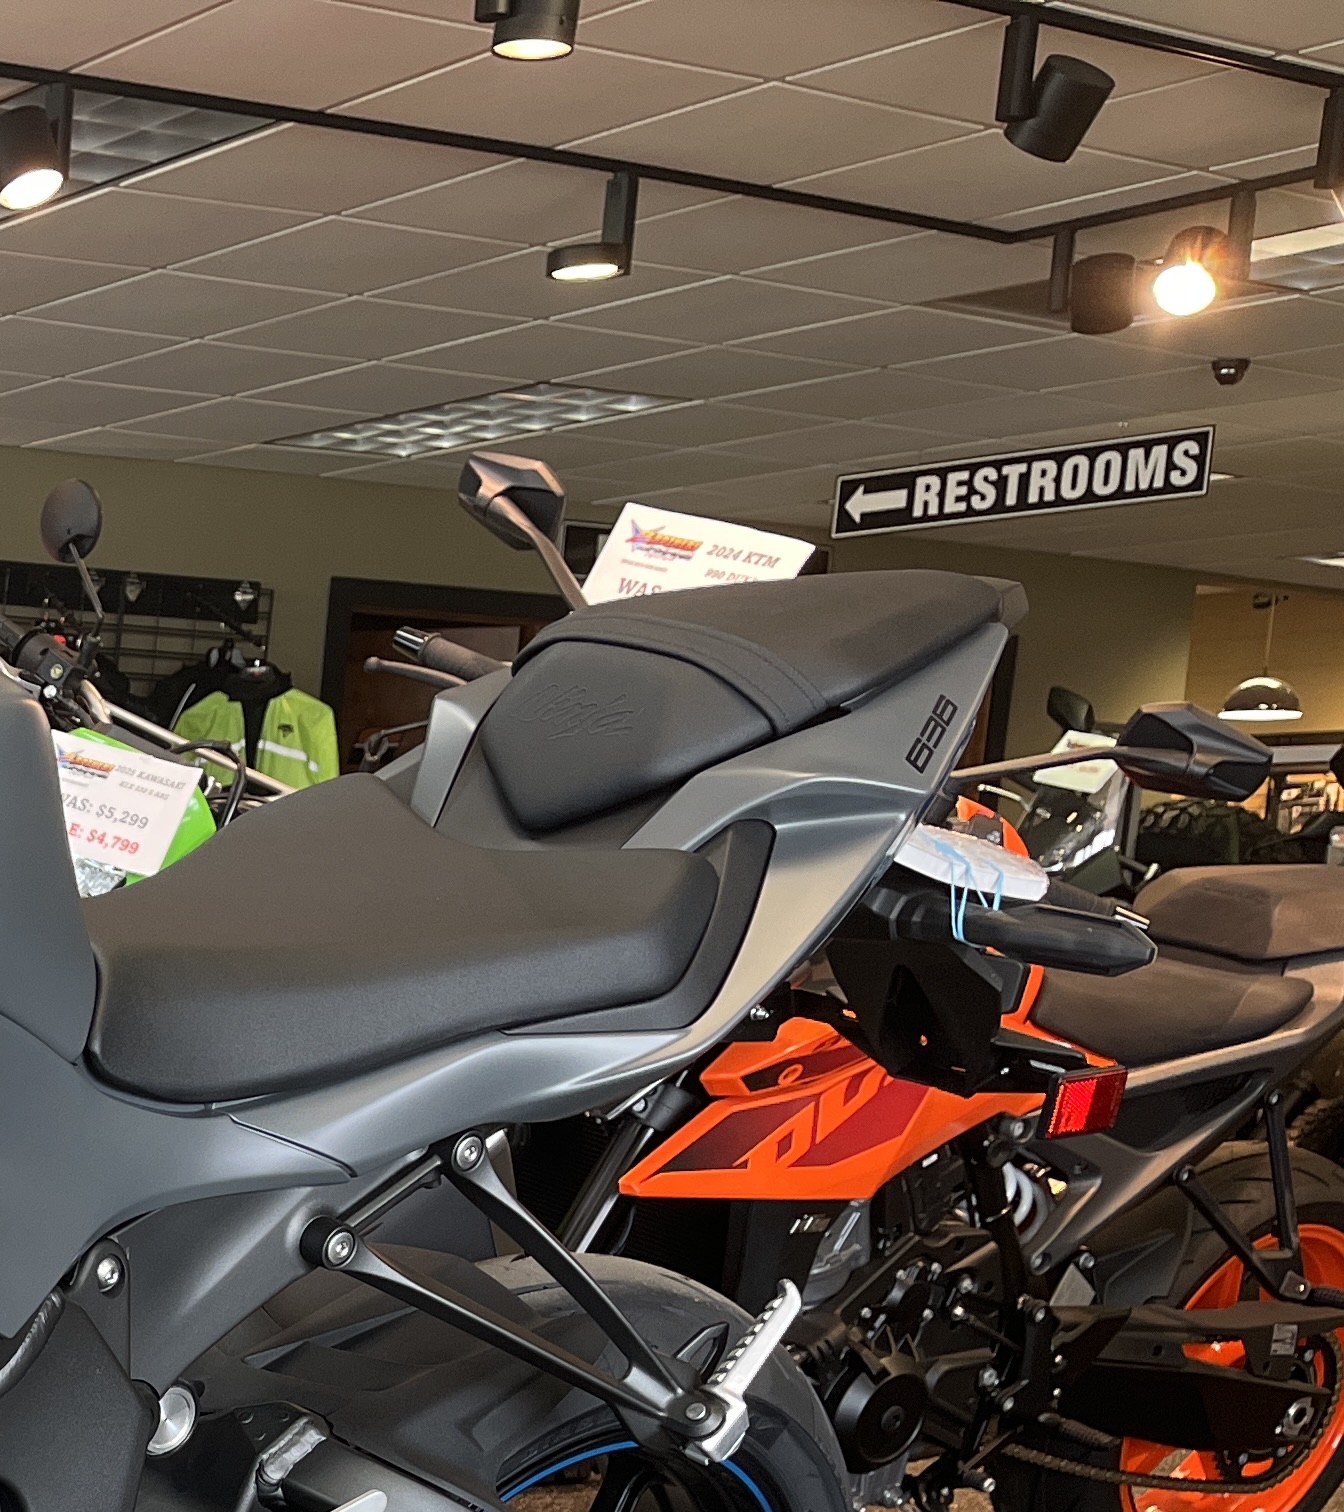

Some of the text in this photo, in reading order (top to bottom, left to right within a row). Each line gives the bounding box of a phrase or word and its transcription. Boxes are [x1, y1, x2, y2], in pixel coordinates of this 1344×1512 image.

[912, 439, 1200, 518] RESTROOMS
[706, 544, 742, 560] 2024
[742, 550, 781, 569] KTM
[905, 694, 958, 774] 636
[136, 770, 187, 791] KAWASAKI
[95, 802, 150, 830] $5,299
[86, 829, 140, 855] $4,799
